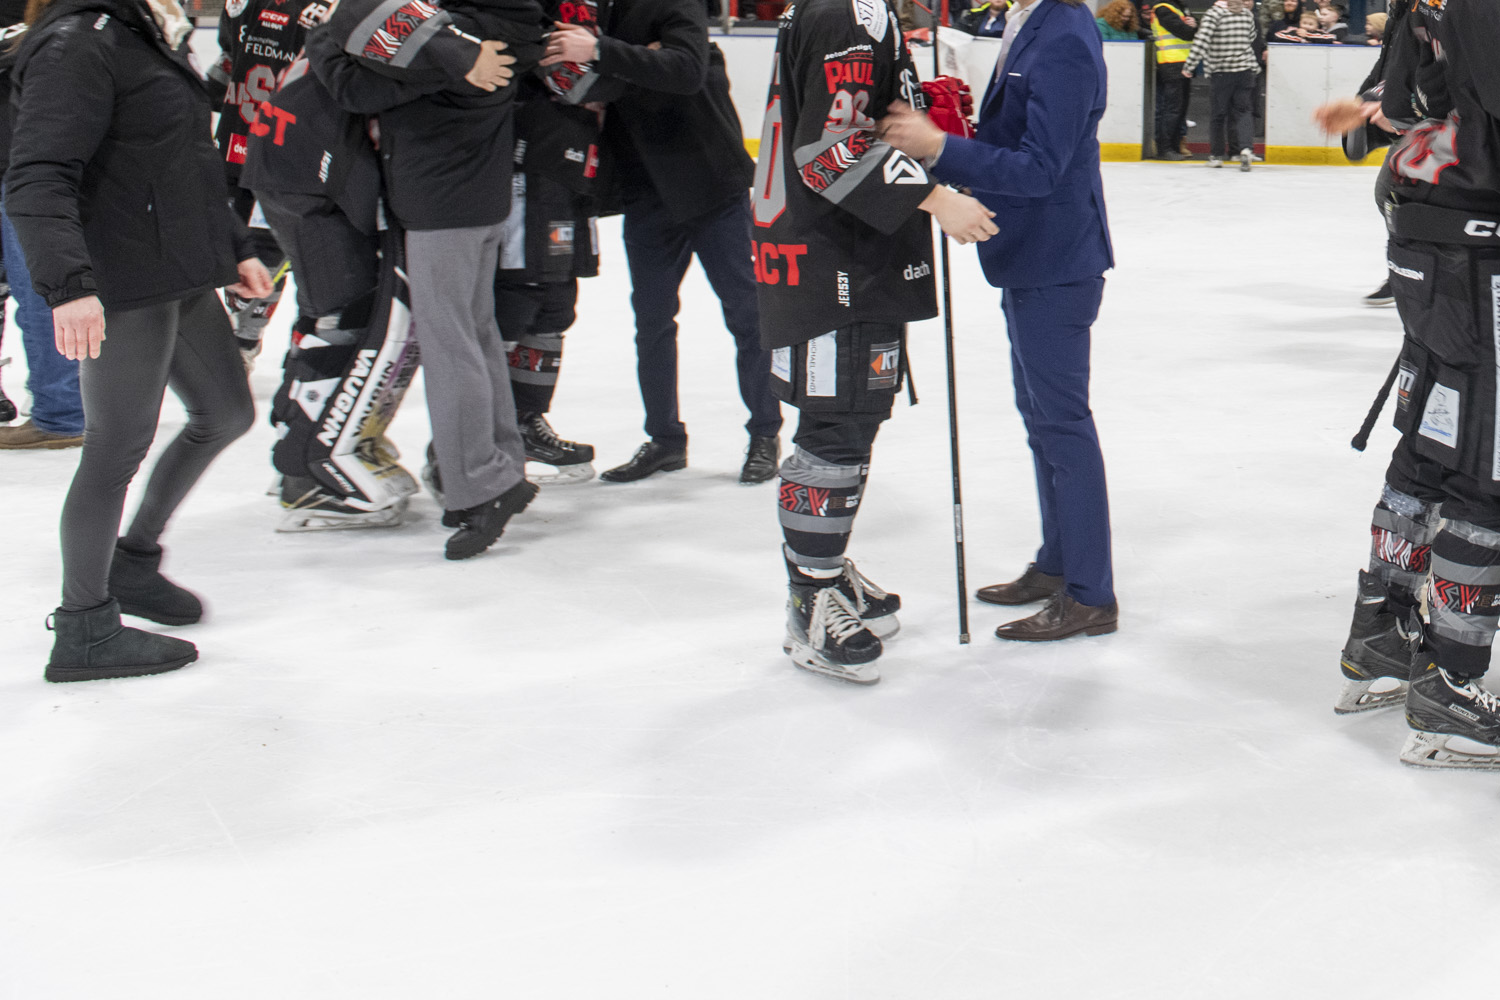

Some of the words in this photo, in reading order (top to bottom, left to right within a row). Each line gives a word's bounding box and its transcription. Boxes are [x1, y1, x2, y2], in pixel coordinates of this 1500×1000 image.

[260, 11, 289, 24] CCM
[823, 60, 875, 94] PAUL
[316, 349, 379, 447] VAUGHN
